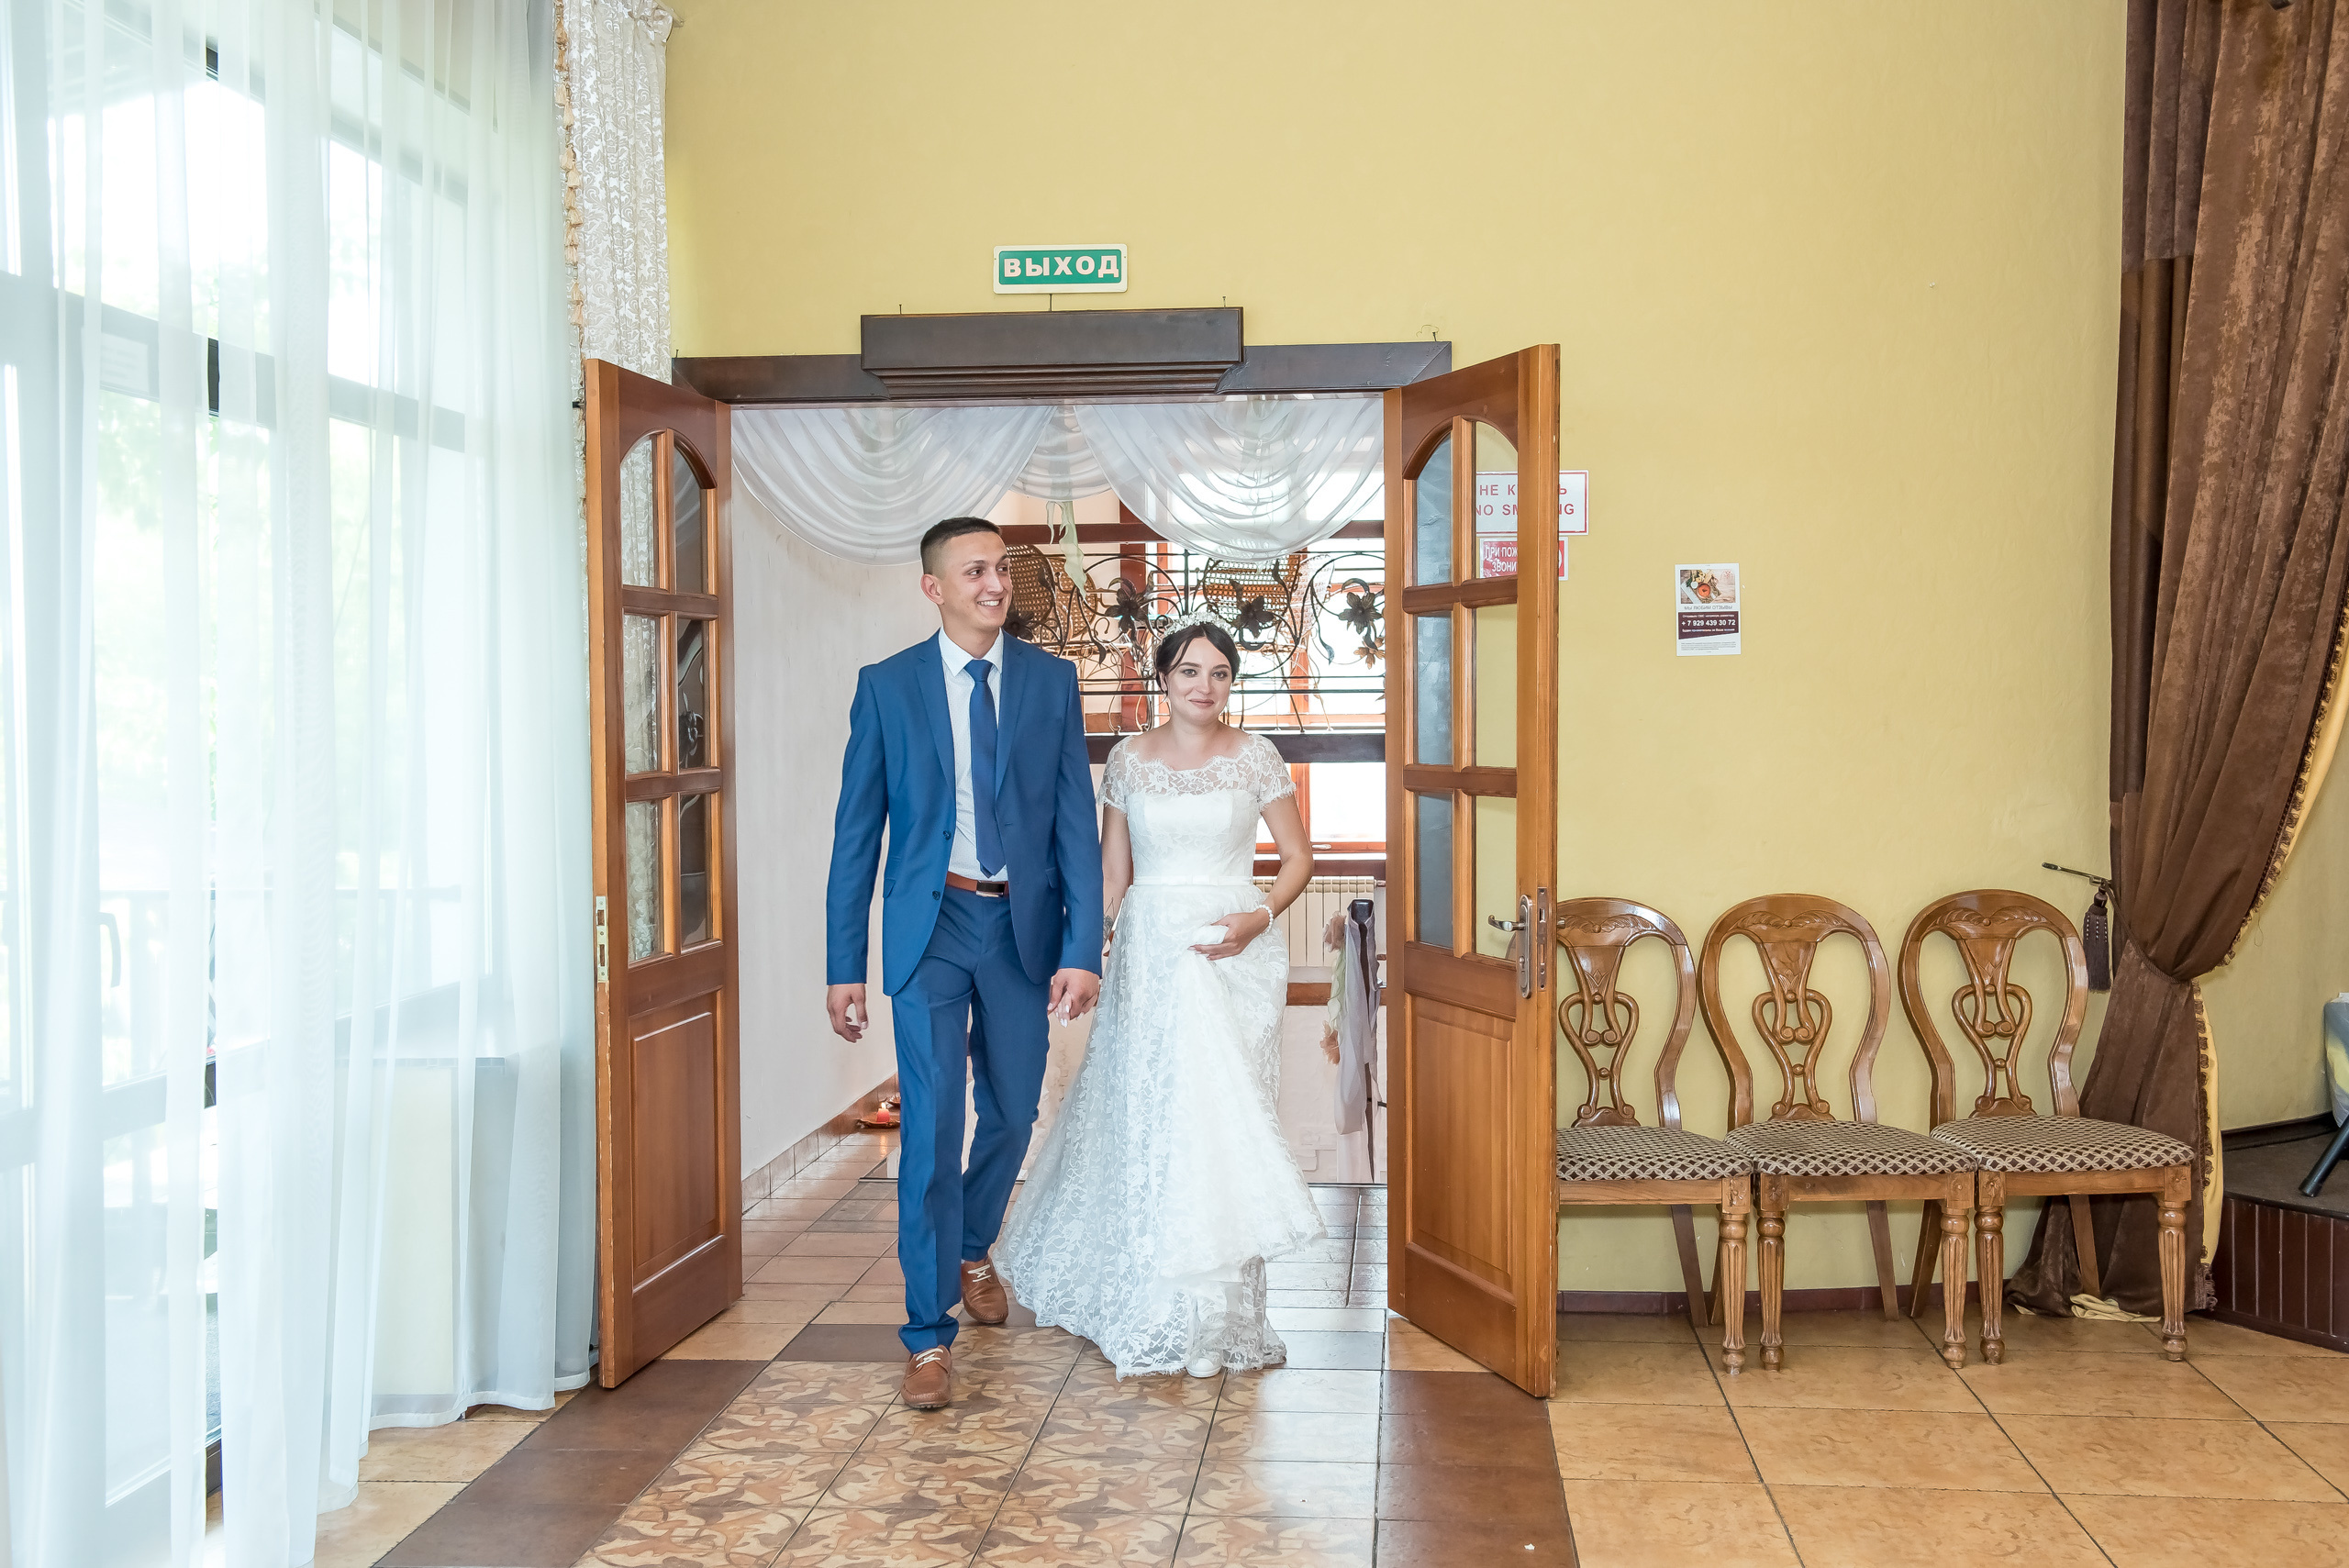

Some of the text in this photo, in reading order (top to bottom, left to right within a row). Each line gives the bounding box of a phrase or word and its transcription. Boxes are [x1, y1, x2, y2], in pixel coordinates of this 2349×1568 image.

[1004, 255, 1119, 278] ВЫХОД
[1479, 484, 1498, 495] НЕ
[1492, 561, 1518, 573] ЗВОНИ
